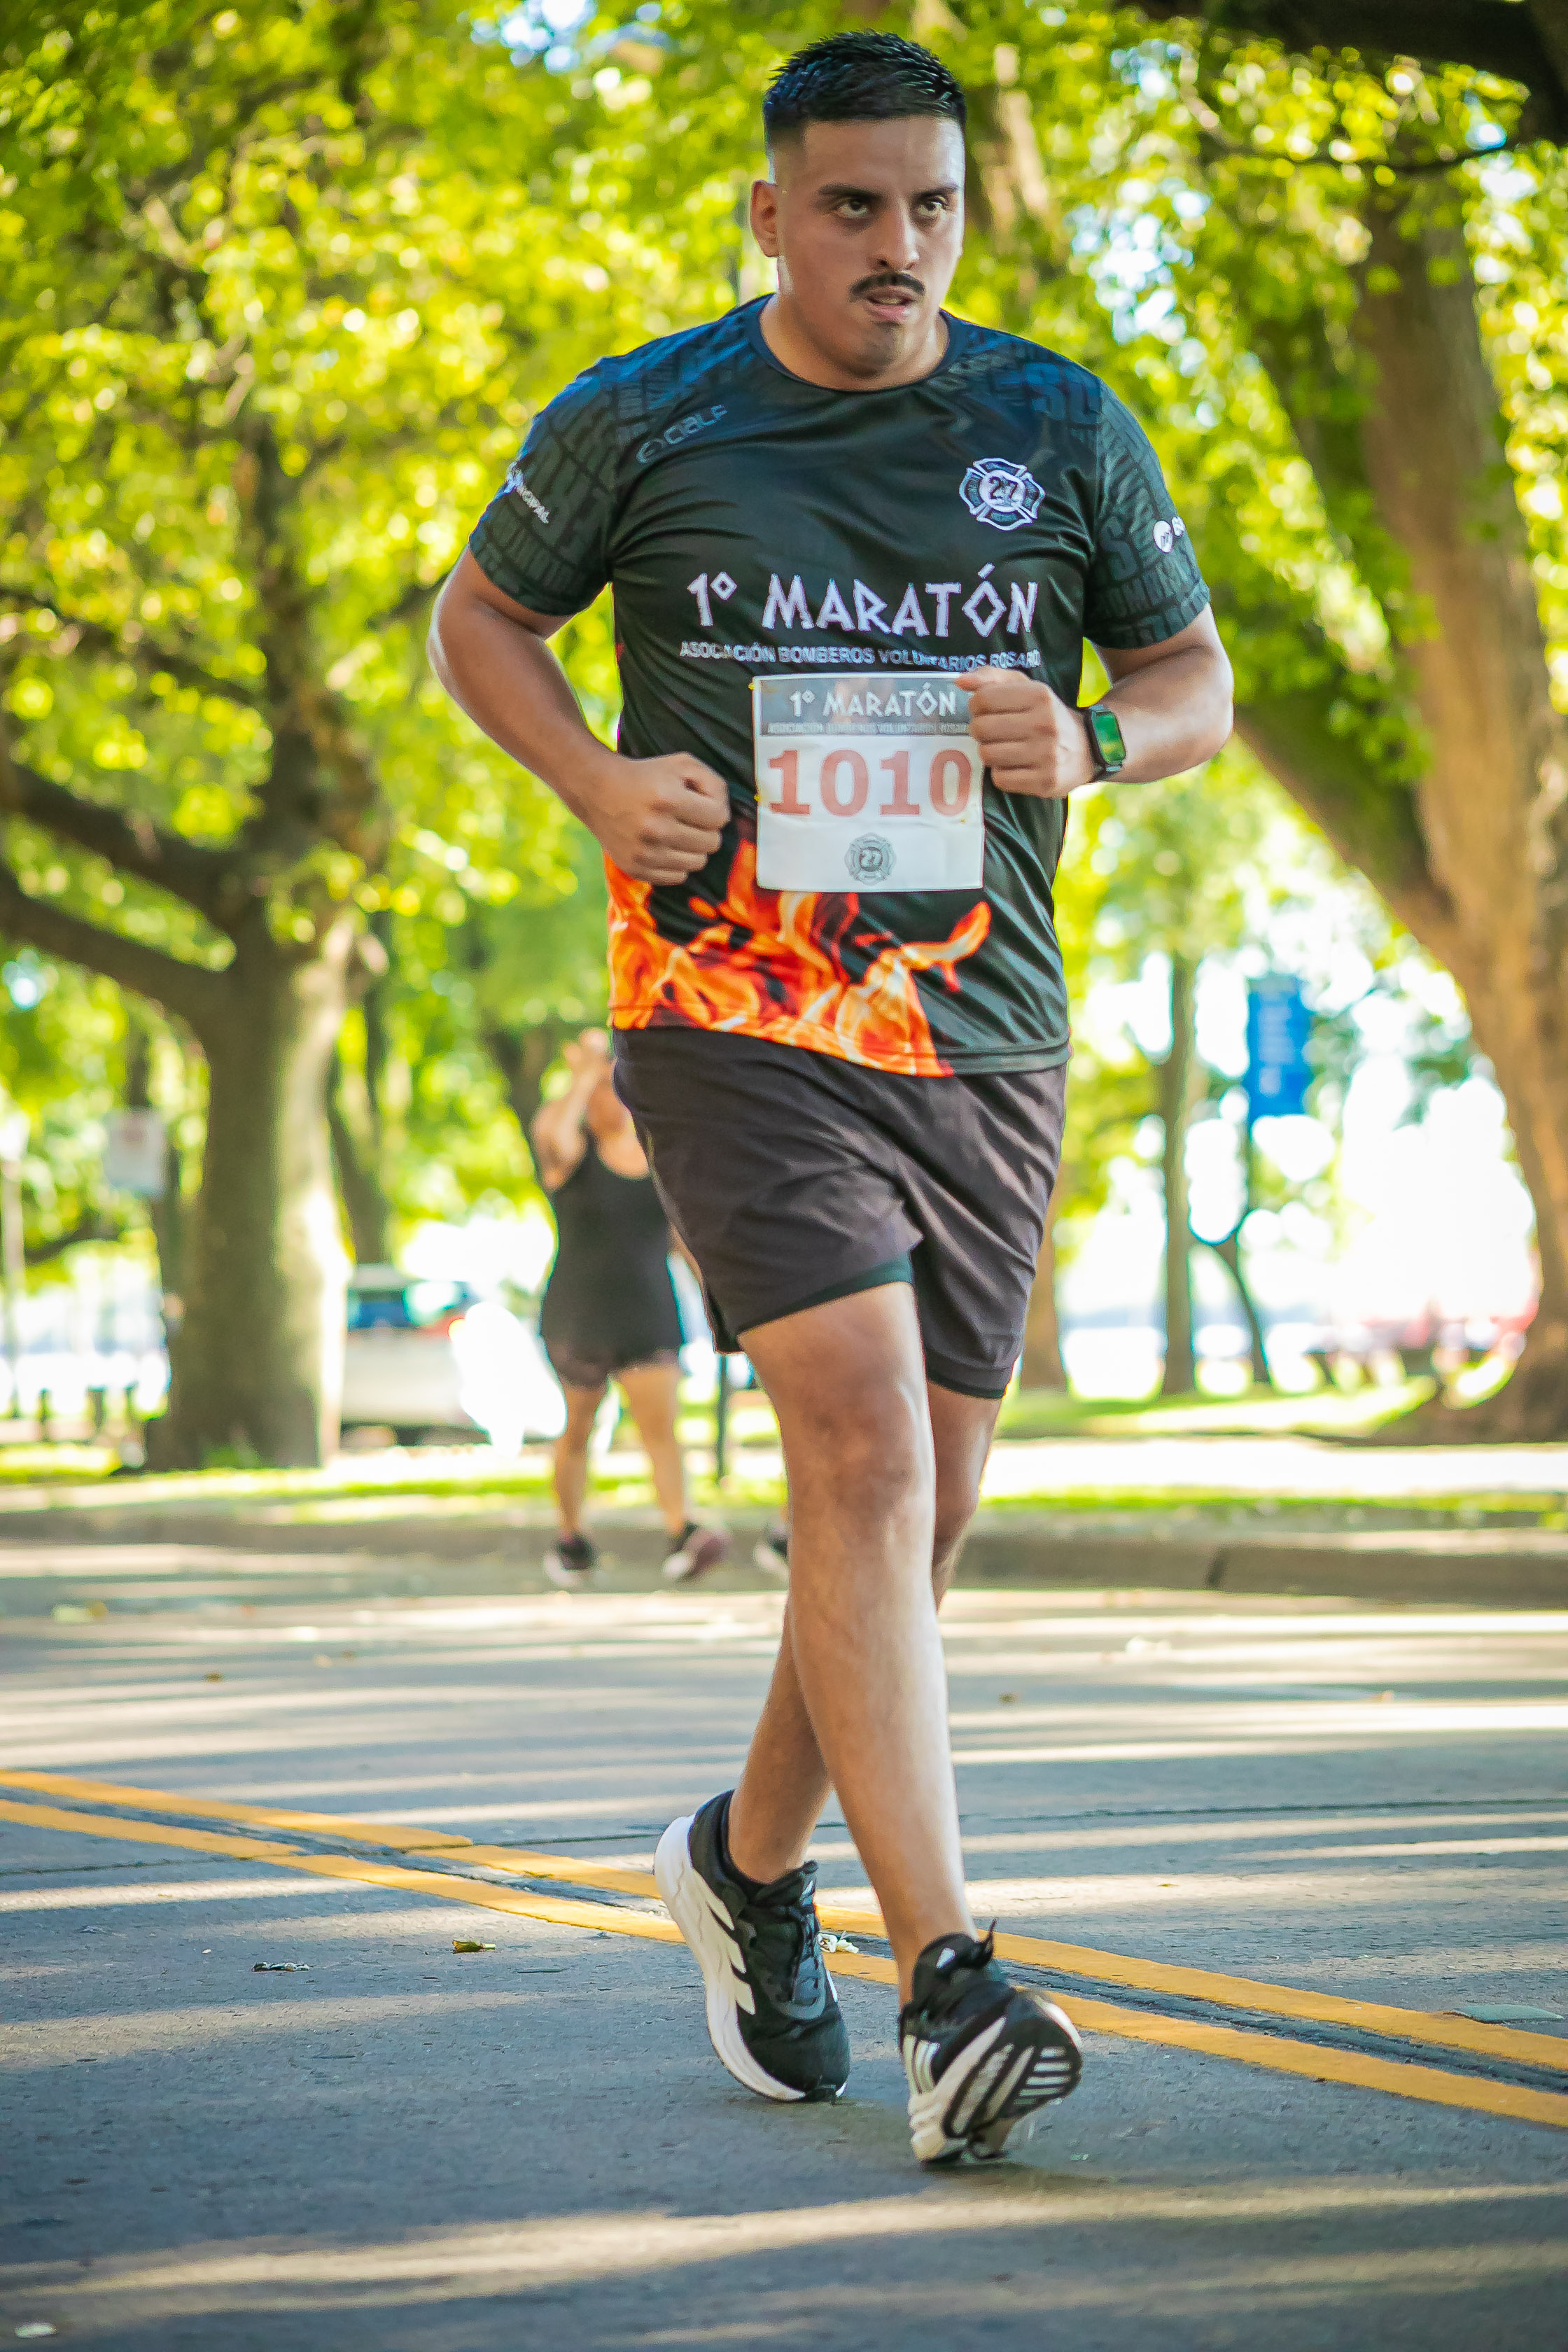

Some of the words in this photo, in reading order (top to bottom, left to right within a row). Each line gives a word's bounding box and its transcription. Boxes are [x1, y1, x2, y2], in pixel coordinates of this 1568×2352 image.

[988, 475, 1018, 500] 27
[762, 562, 1037, 638] MARATÓN
[778, 645, 875, 664] BOMBEROS
[822, 681, 956, 718] MARATÓN
[768, 748, 972, 818] 1010
